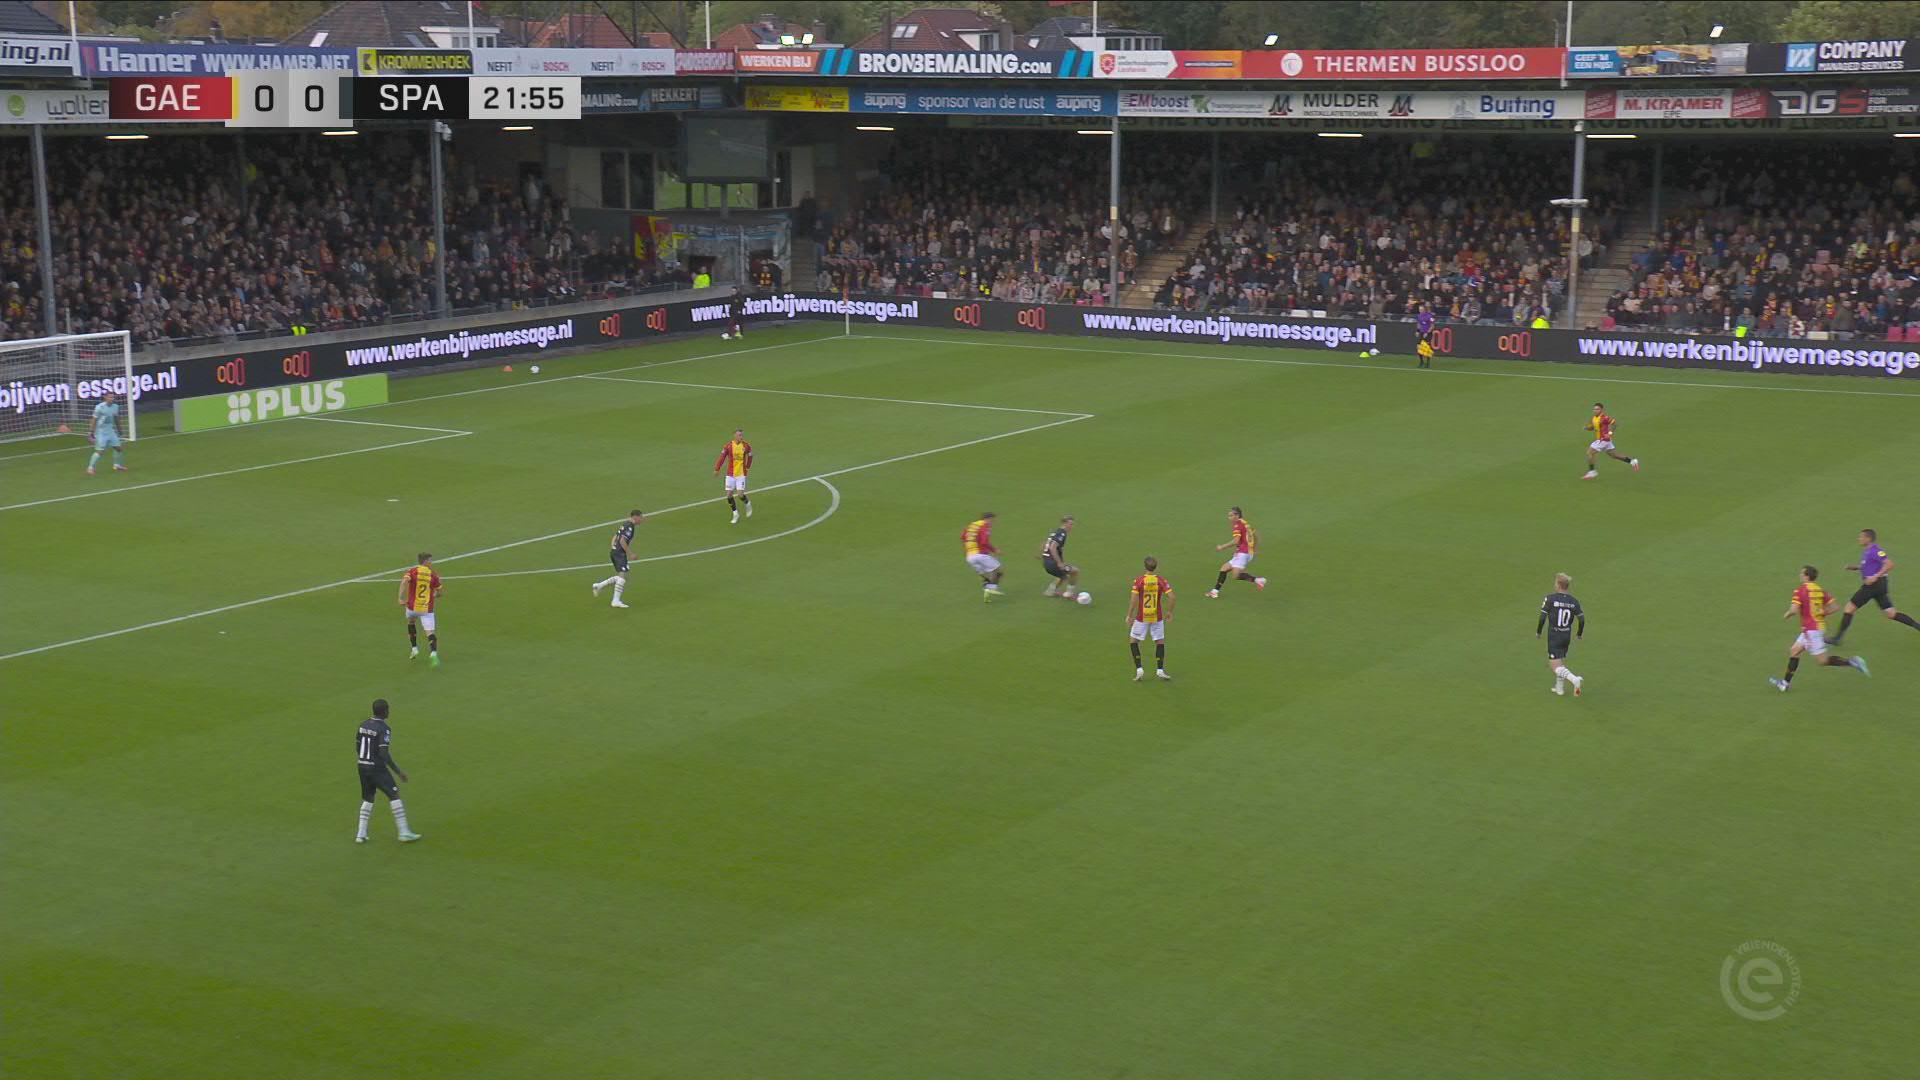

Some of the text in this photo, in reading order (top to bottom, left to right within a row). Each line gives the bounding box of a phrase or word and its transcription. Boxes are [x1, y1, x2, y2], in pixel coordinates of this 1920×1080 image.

[1819, 40, 1907, 59] COMPANY
[97, 47, 350, 72] Hamer WWW.HAMER.NET
[378, 55, 471, 70] KROMMENHOEK
[487, 61, 512, 72] NEFIT
[543, 61, 569, 72] BOSCH
[591, 61, 615, 72] NEFIT
[641, 61, 665, 72] BOSCH
[740, 55, 791, 67] WERKEN
[792, 55, 812, 68] BIJ
[1313, 54, 1526, 73] THERMEN BUSSLOO
[1818, 59, 1904, 71] MANAGED SERVICES
[864, 93, 906, 109] auping
[918, 94, 1045, 110] sponsor van de rust
[1056, 95, 1102, 112] auping
[1303, 93, 1380, 108] MULDER
[1480, 95, 1555, 119] Buiting
[1624, 99, 1642, 110] M.
[1645, 98, 1723, 110] KRAMER
[690, 293, 919, 322] www.rkenbijwemessage.nl
[1083, 312, 1377, 348] www.werkenbijwemessage.nl
[345, 319, 572, 365] www.werkenbijwemessage.nl
[1578, 337, 1920, 375] www.werkenbijwemessage
[256, 380, 345, 420] PLUS
[418, 584, 427, 598] 2
[1143, 594, 1157, 608] 21
[1557, 608, 1571, 627] 10
[360, 736, 371, 760] 11
